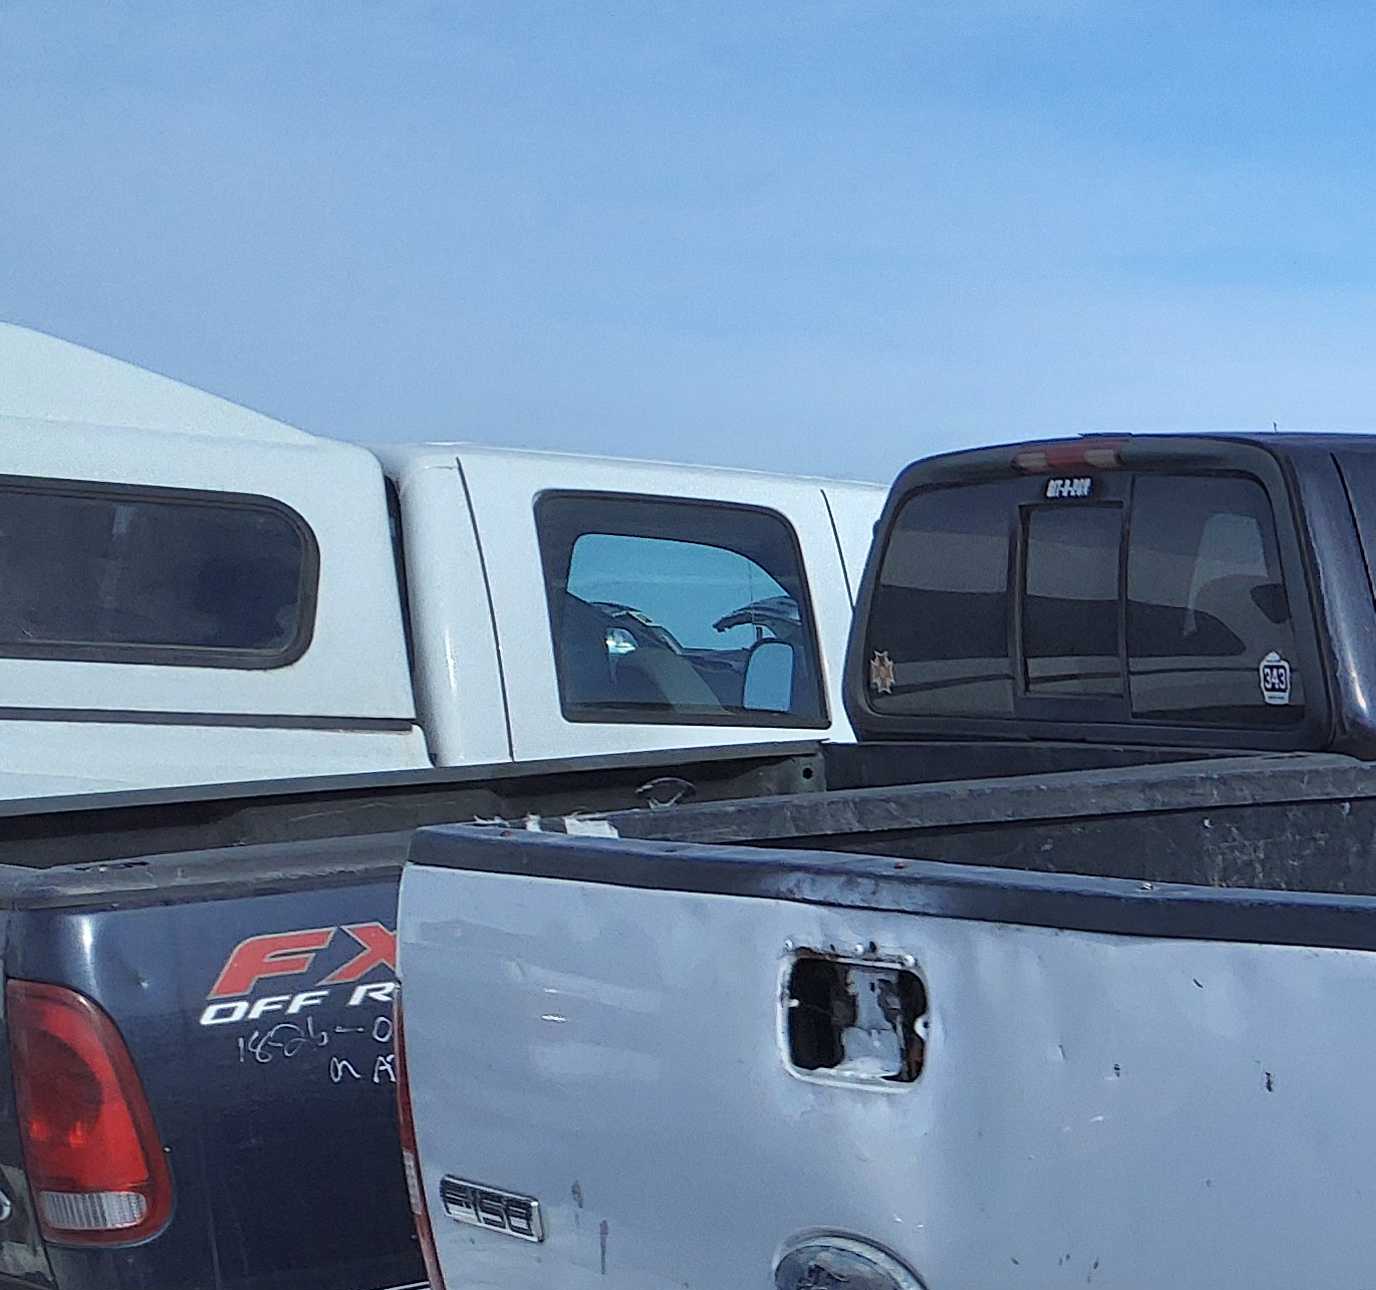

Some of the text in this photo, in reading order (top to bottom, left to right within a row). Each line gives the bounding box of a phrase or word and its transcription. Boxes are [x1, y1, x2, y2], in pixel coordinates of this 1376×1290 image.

[1263, 668, 1286, 689] 343
[200, 991, 328, 1025] OFF
[373, 1054, 397, 1083] A
